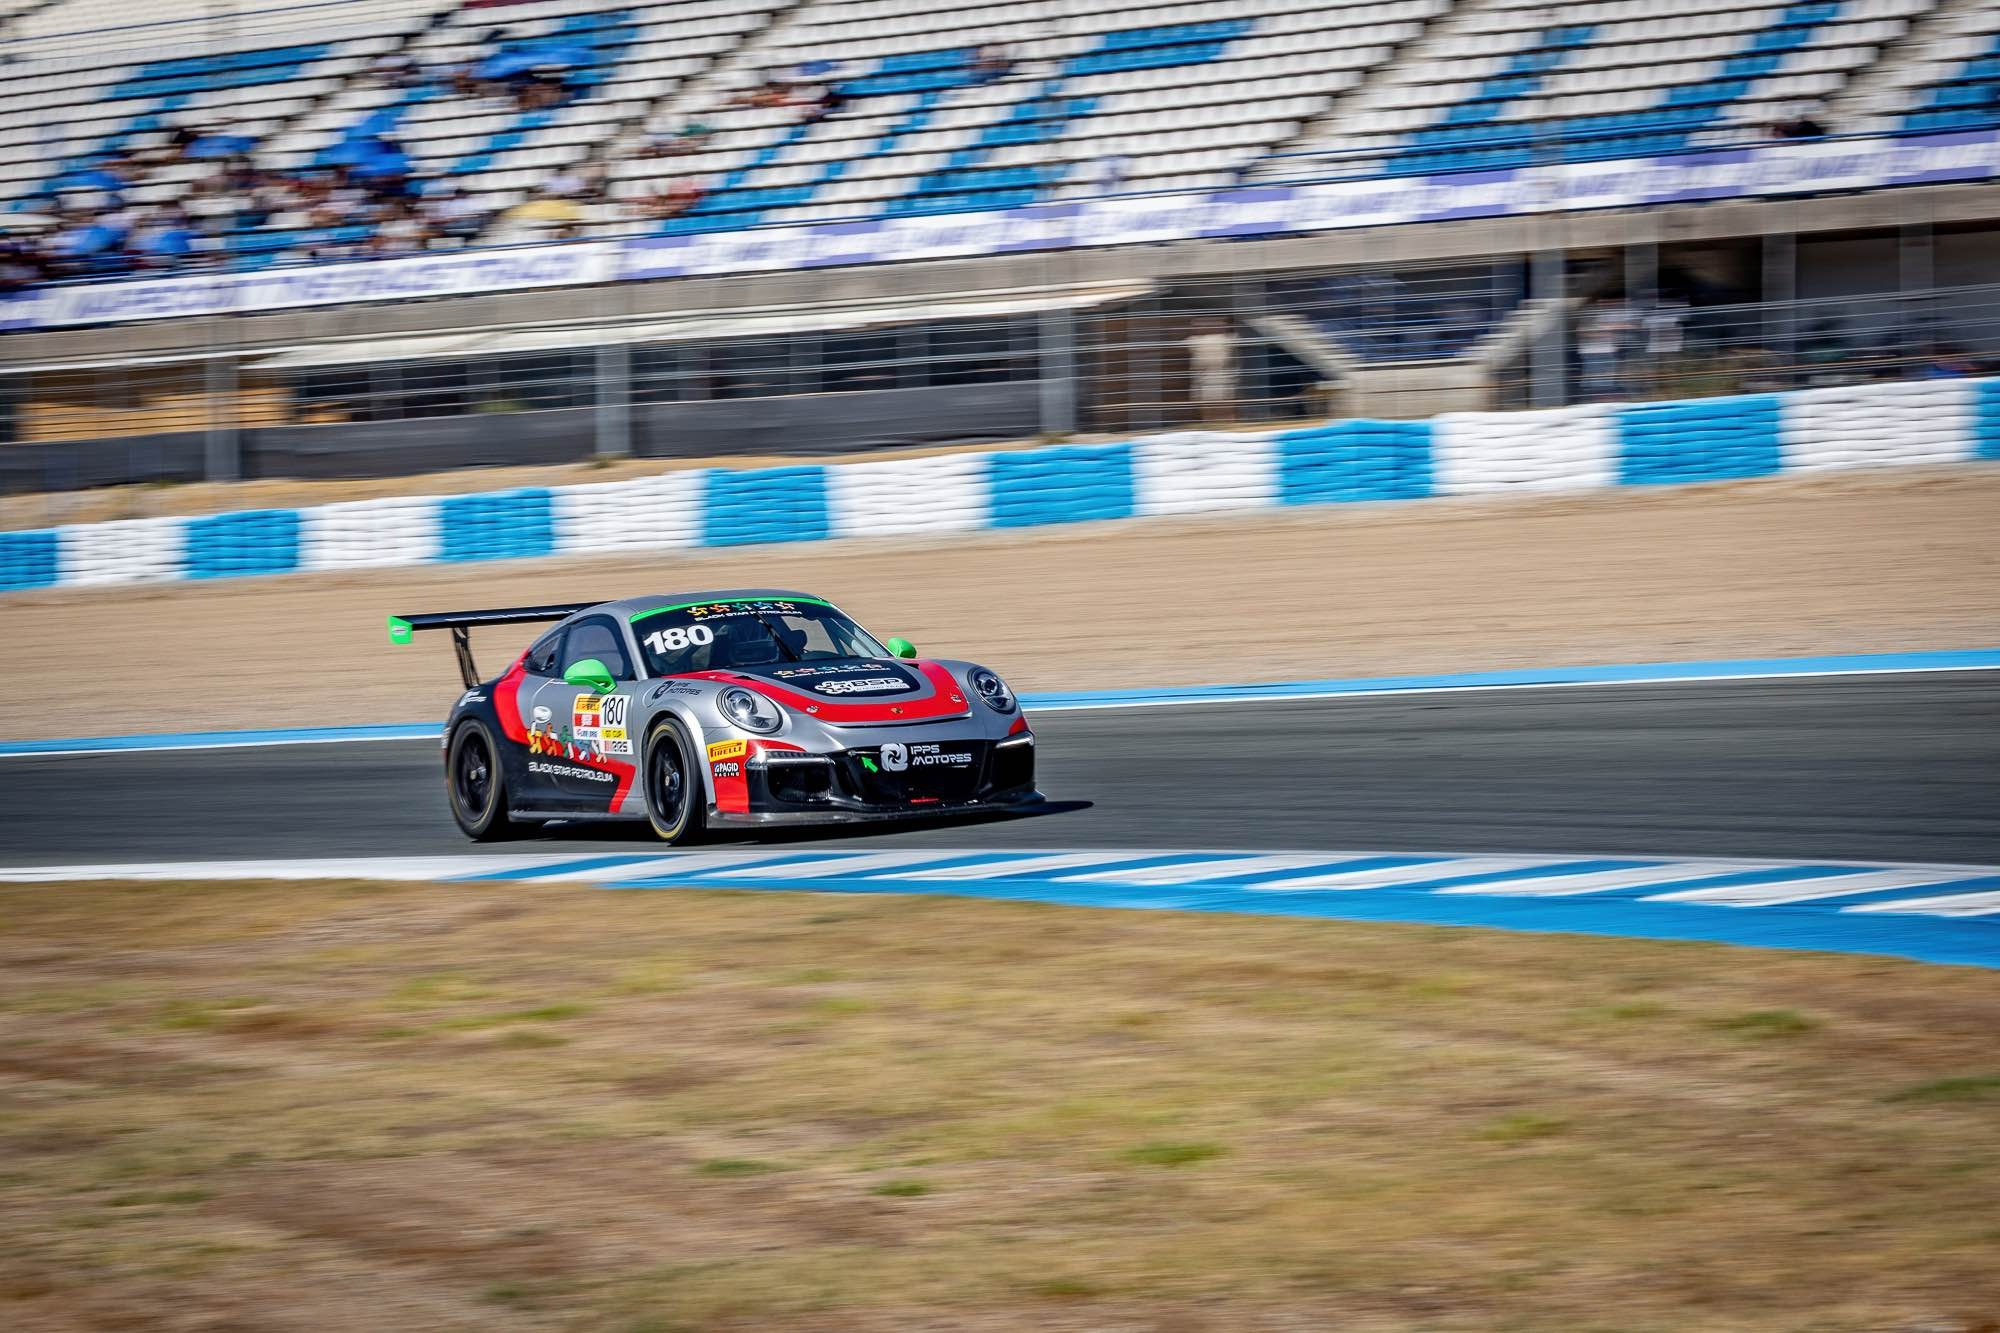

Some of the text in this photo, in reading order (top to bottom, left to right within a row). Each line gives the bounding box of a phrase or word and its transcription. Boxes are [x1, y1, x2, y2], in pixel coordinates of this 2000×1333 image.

[643, 625, 714, 655] 180
[602, 697, 624, 725] 180
[710, 742, 742, 758] PIRELLI
[910, 744, 940, 755] IPPS
[719, 762, 739, 772] PAGID
[912, 753, 972, 766] MOTORES
[528, 761, 553, 774] BLACK
[553, 765, 571, 777] STAR
